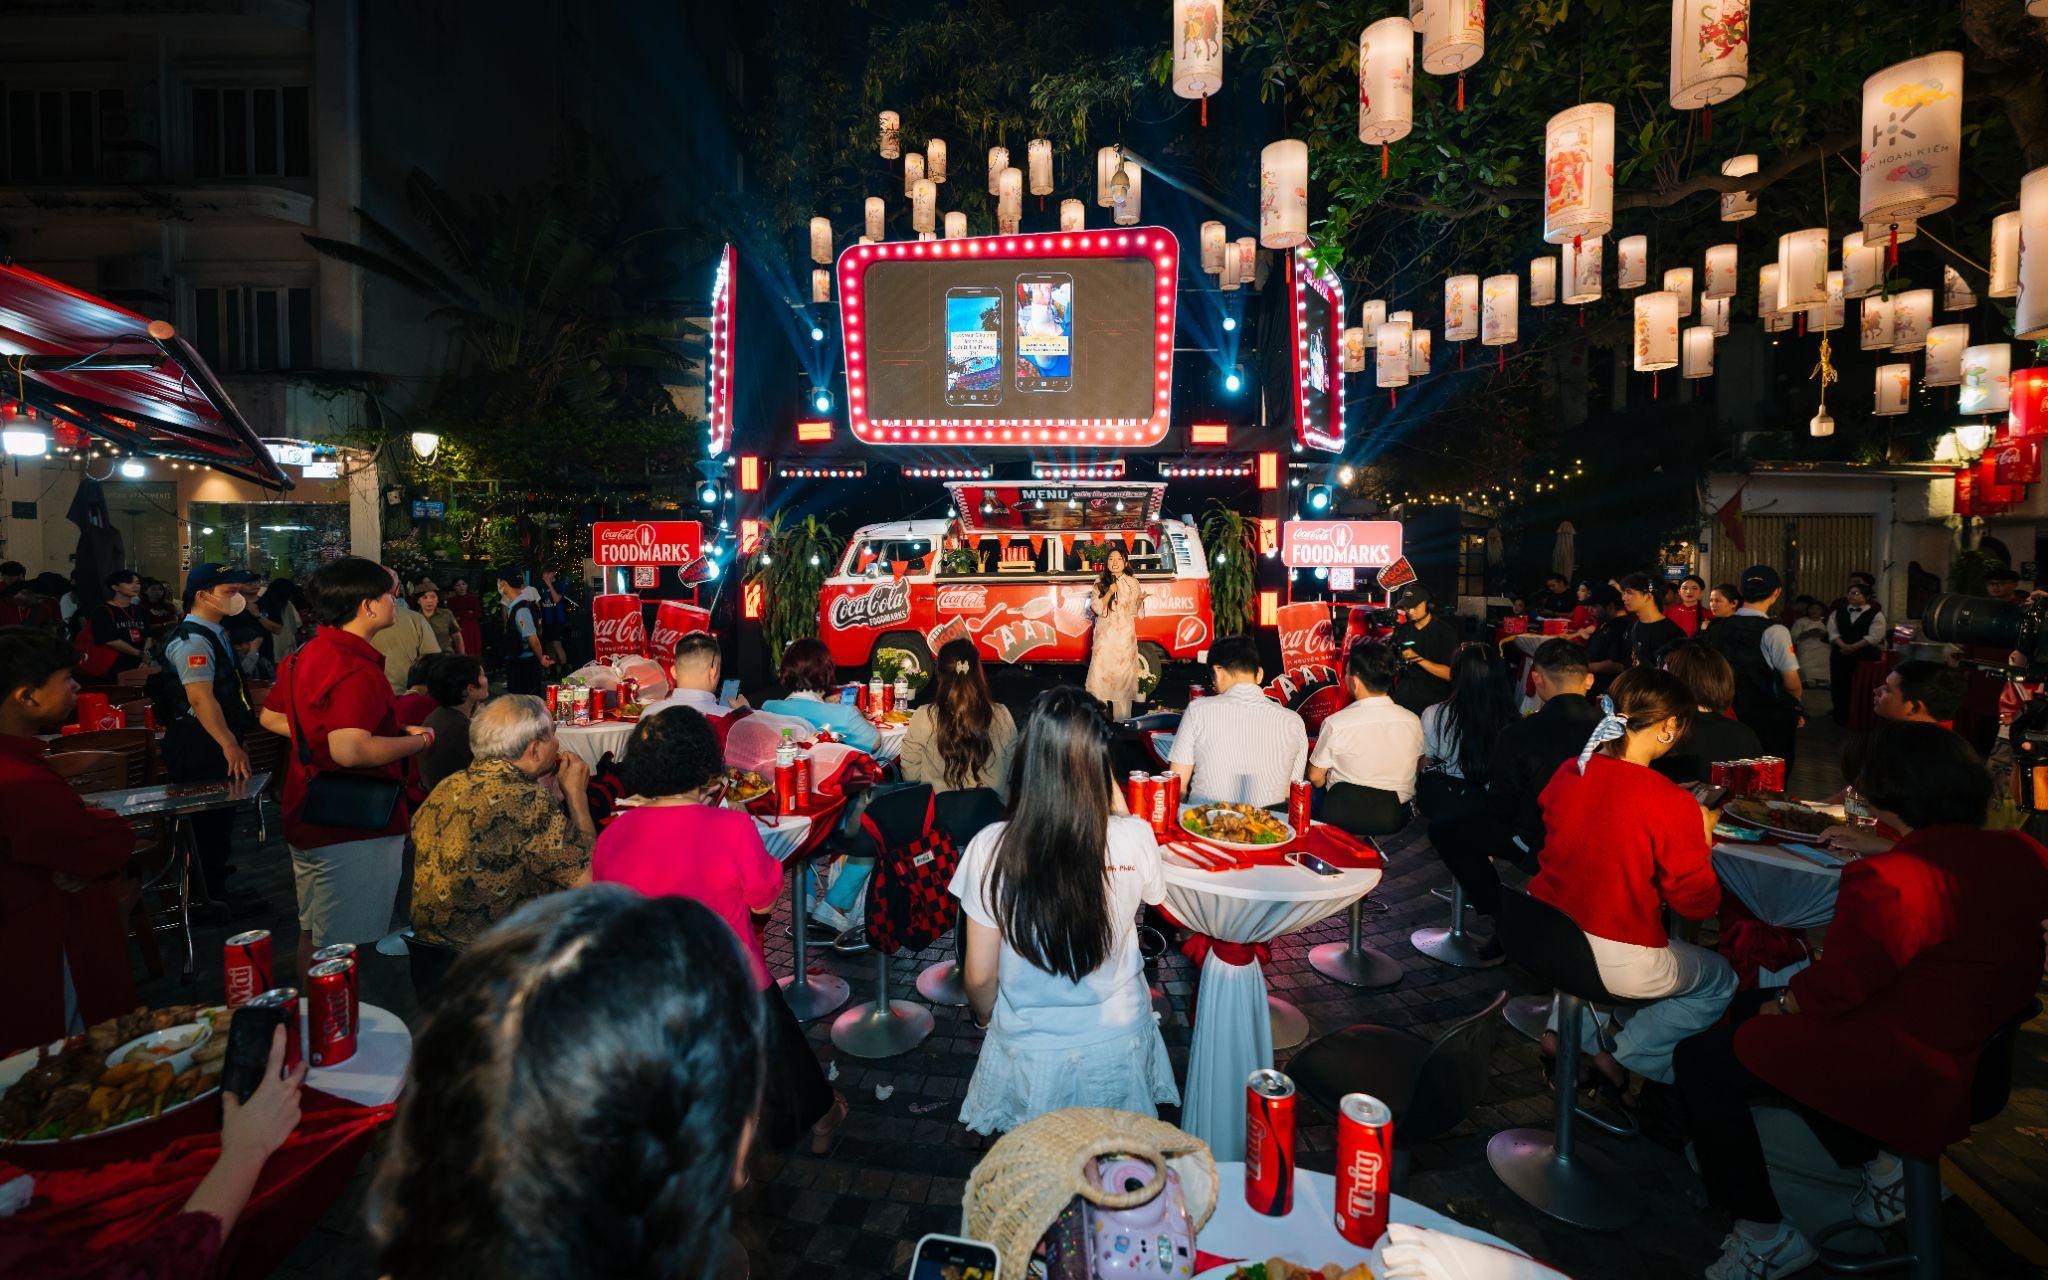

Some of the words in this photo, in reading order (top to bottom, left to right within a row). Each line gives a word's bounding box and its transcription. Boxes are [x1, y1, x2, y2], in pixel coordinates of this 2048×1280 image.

[1022, 489, 1068, 500] MENU
[602, 528, 635, 540] Coca-Cola
[1293, 528, 1330, 540] Coca-Cola
[601, 544, 690, 562] FOODMARKS
[1292, 544, 1390, 563] FOODMARKS
[833, 583, 903, 627] Coca-Cola
[941, 591, 985, 607] Coca-Cola
[869, 610, 907, 626] FOODMARKS
